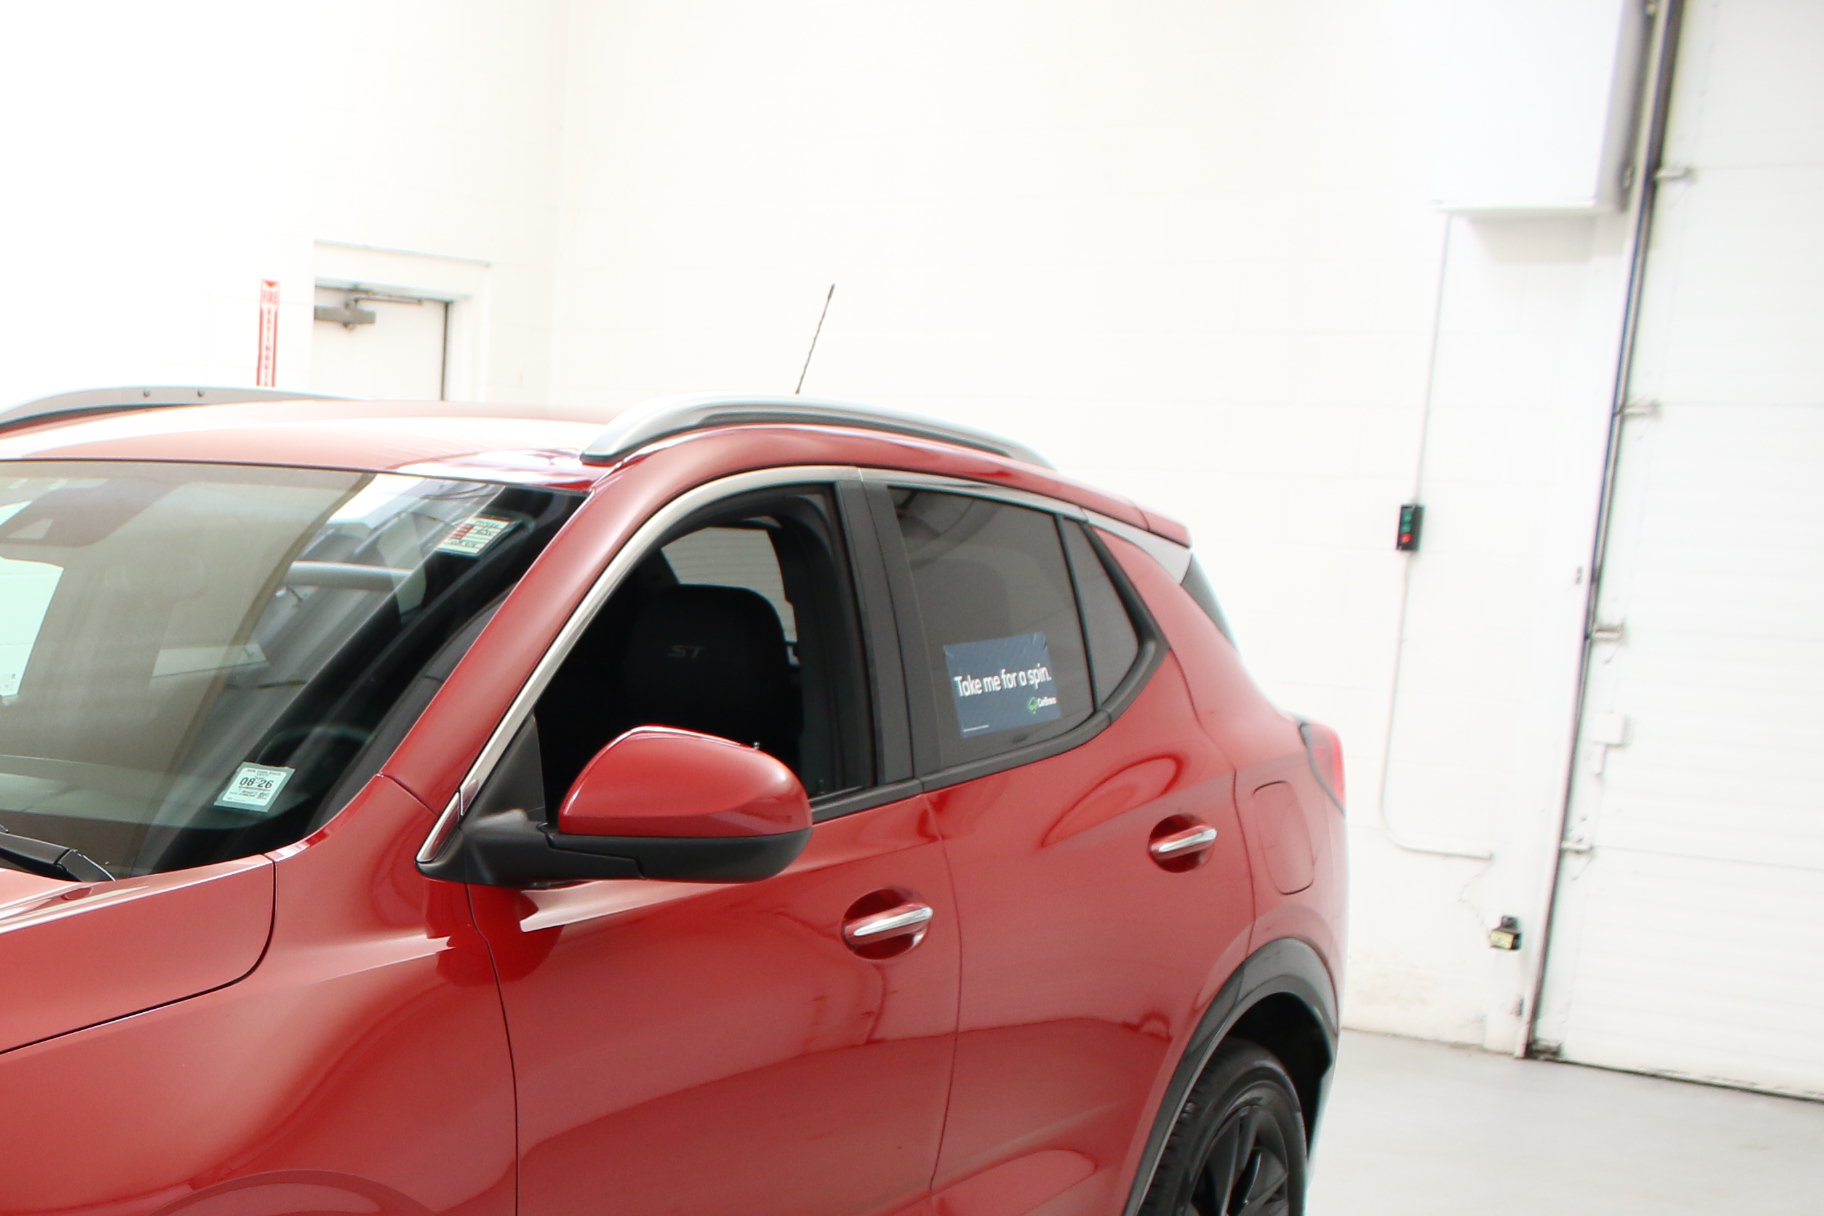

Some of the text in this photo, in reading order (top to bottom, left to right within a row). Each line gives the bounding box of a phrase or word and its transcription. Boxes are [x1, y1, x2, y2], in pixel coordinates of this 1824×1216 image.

[667, 645, 706, 660] ST
[953, 663, 1051, 697] Take me for a spin.
